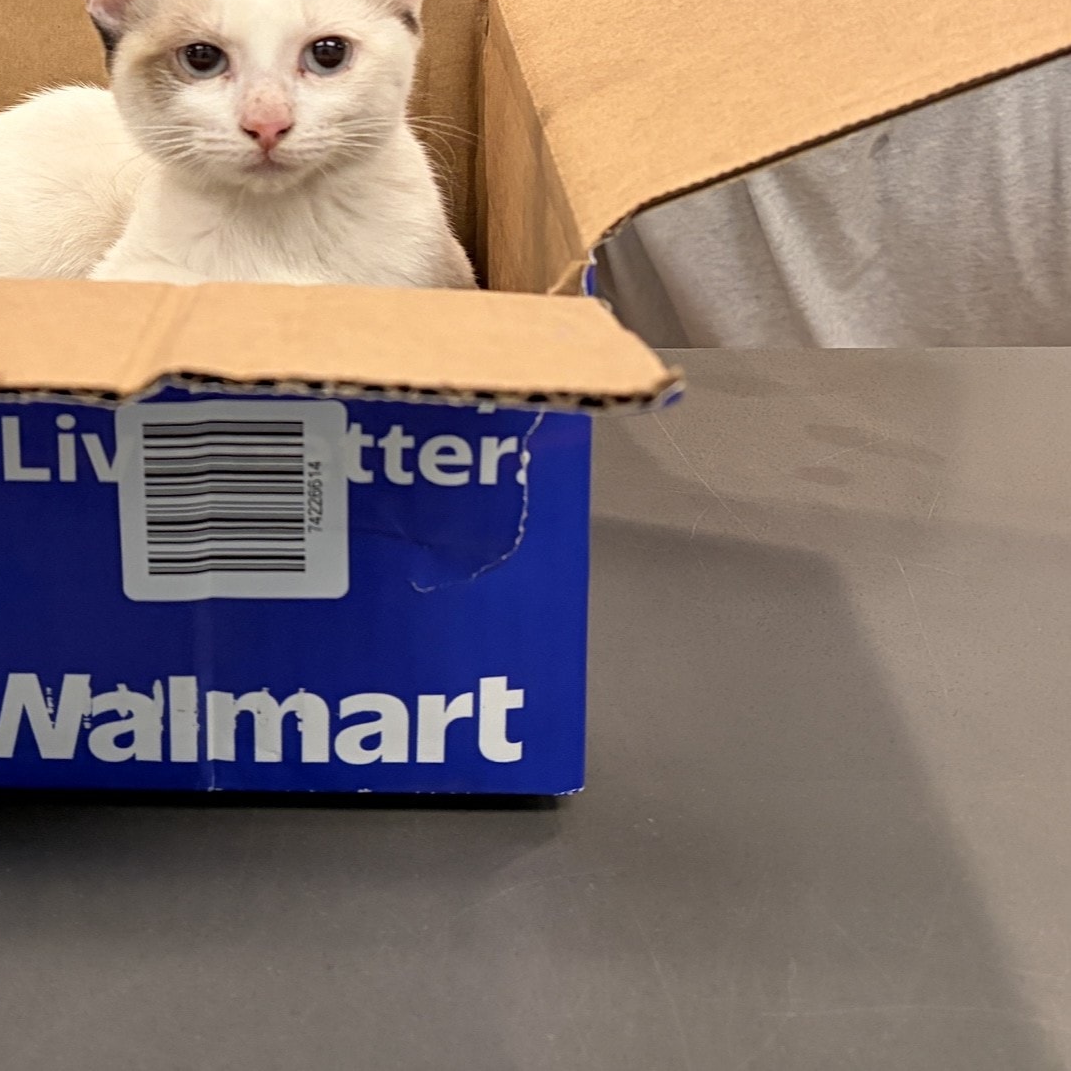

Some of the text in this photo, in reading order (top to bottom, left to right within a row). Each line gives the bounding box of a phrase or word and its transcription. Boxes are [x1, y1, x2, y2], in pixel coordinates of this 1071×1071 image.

[1, 413, 527, 487] Liv tter.
[307, 461, 323, 533] 74226614
